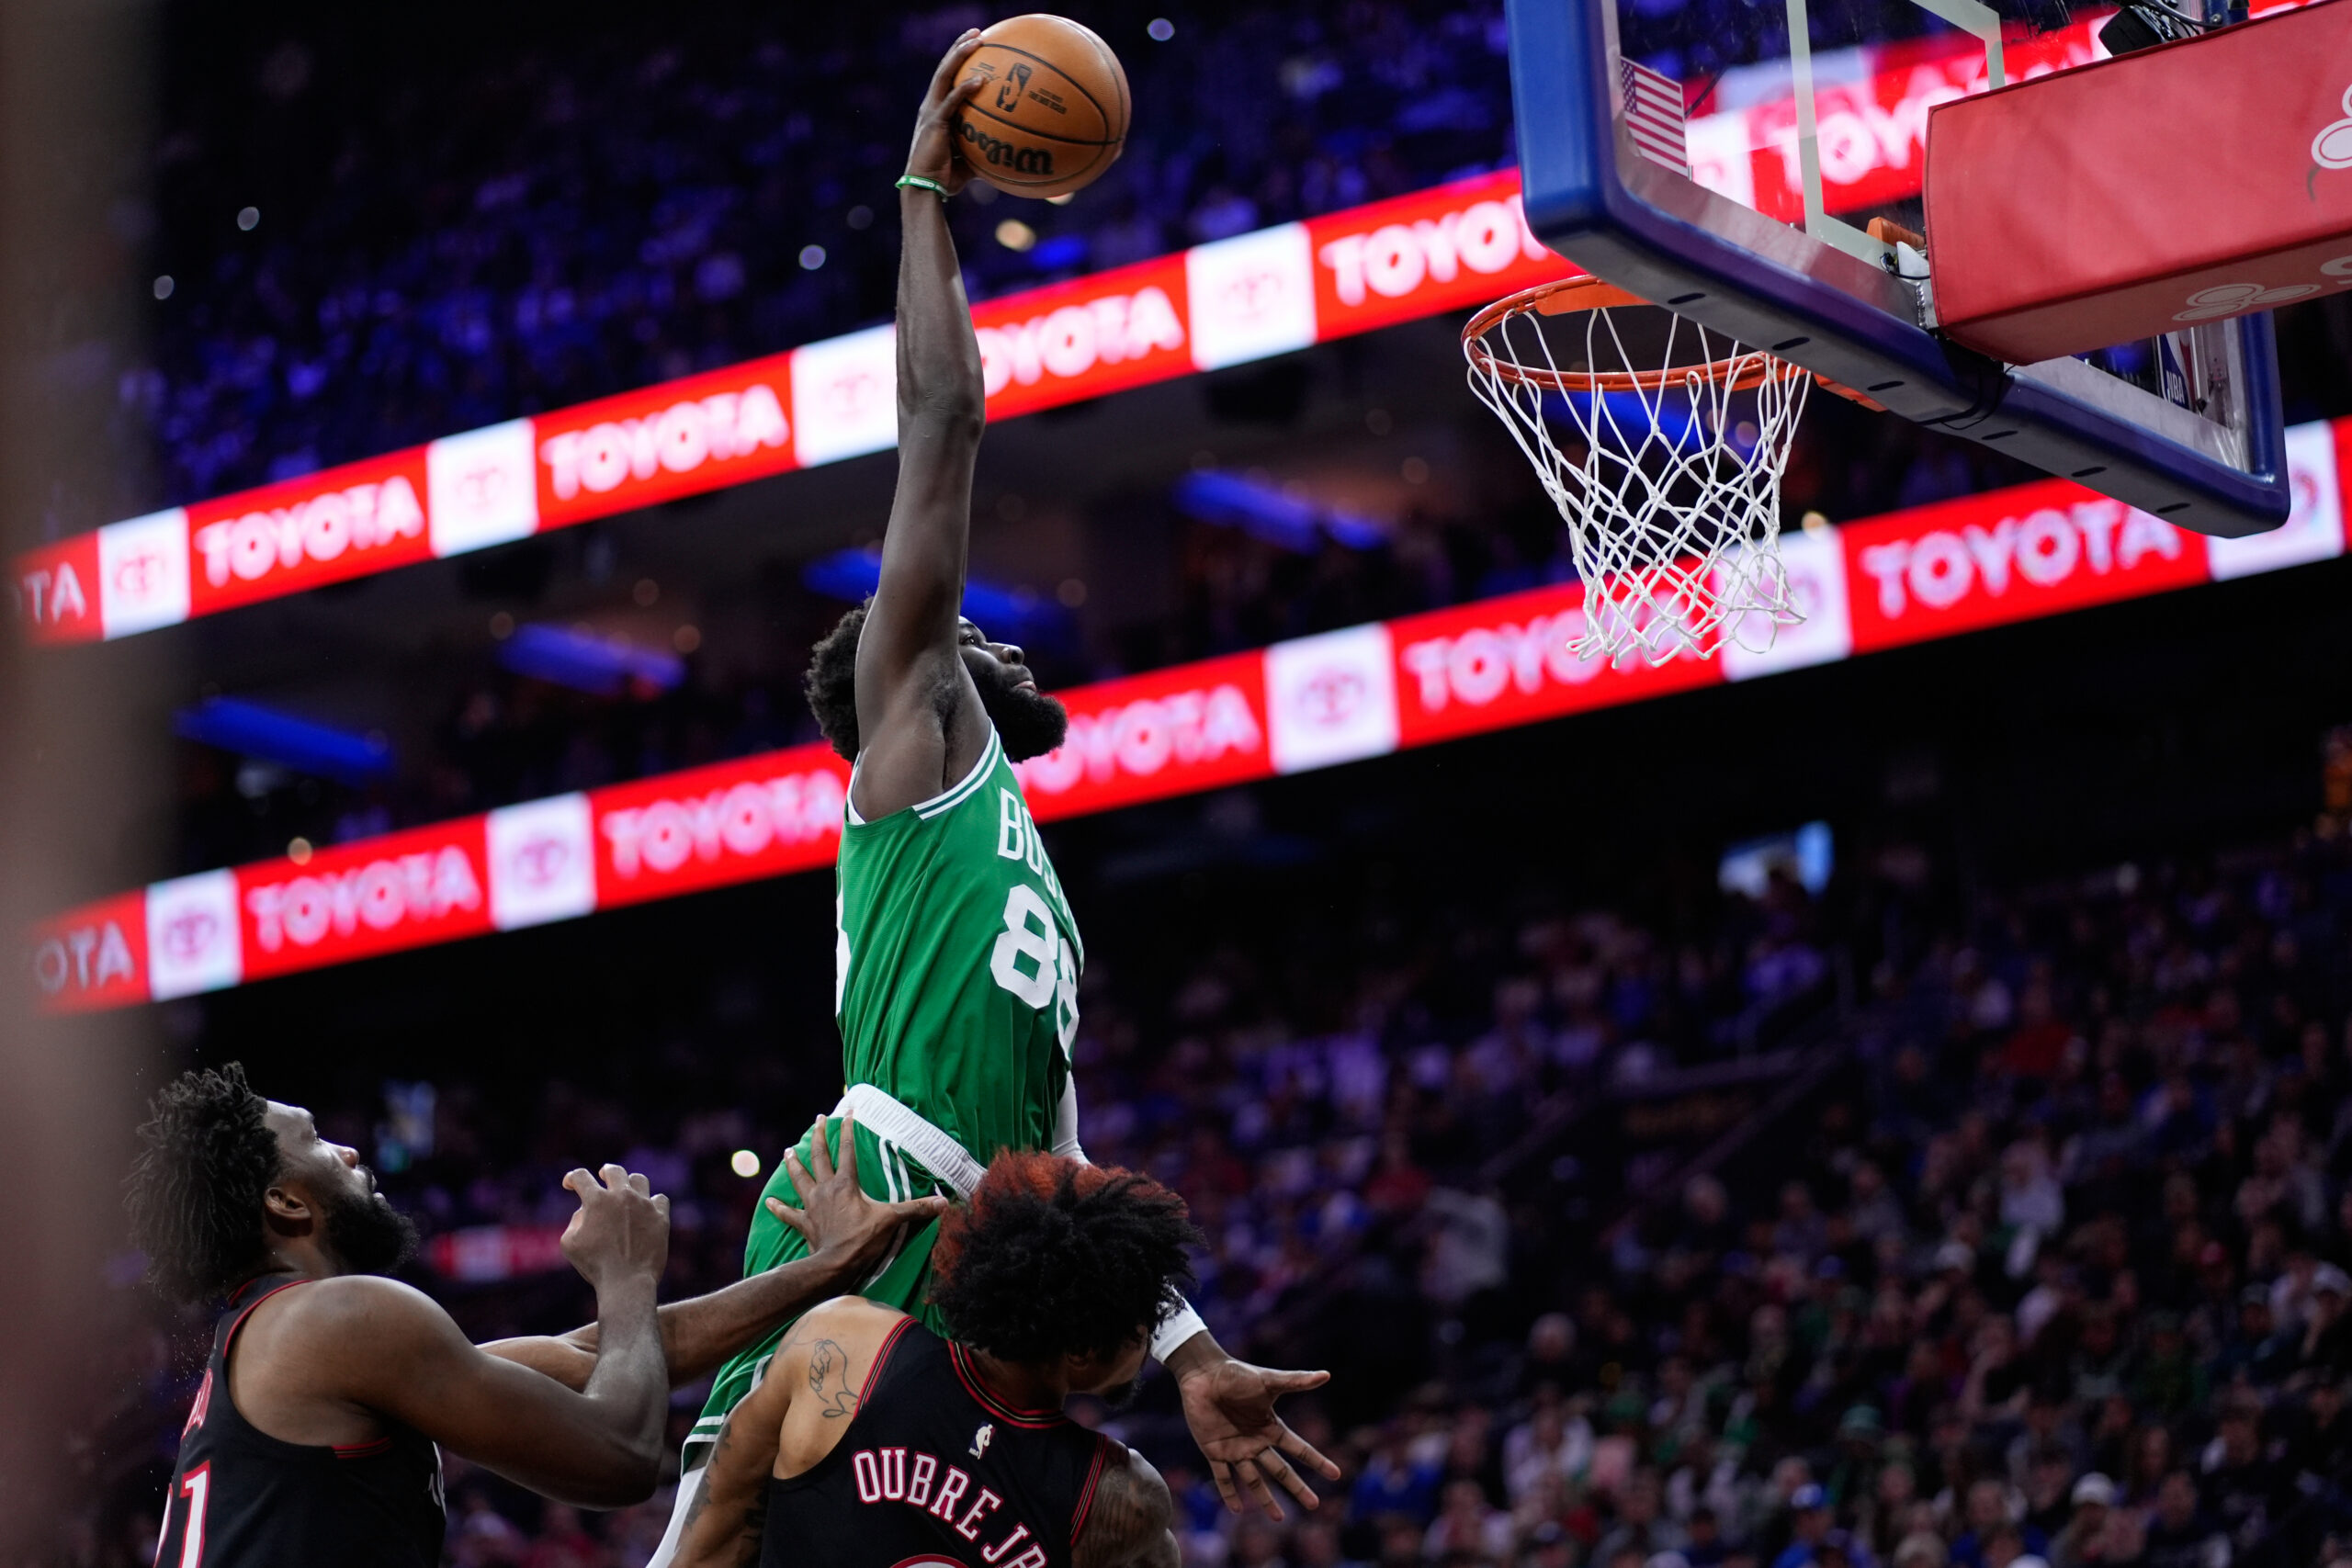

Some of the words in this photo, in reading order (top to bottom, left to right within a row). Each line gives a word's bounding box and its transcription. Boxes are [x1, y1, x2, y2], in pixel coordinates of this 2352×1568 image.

[973, 287, 1185, 399] OYOTA
[2165, 369, 2194, 405] NBA
[539, 383, 790, 501] TOYOTA
[193, 472, 424, 588] TOYOTA
[1862, 499, 2182, 618] TOYOTA
[1013, 683, 1261, 795] OYOTA
[601, 770, 843, 879] TOYOTA
[245, 844, 483, 953] TOYOTA
[35, 921, 134, 996] OTA
[853, 1446, 1003, 1543] OUBRE
